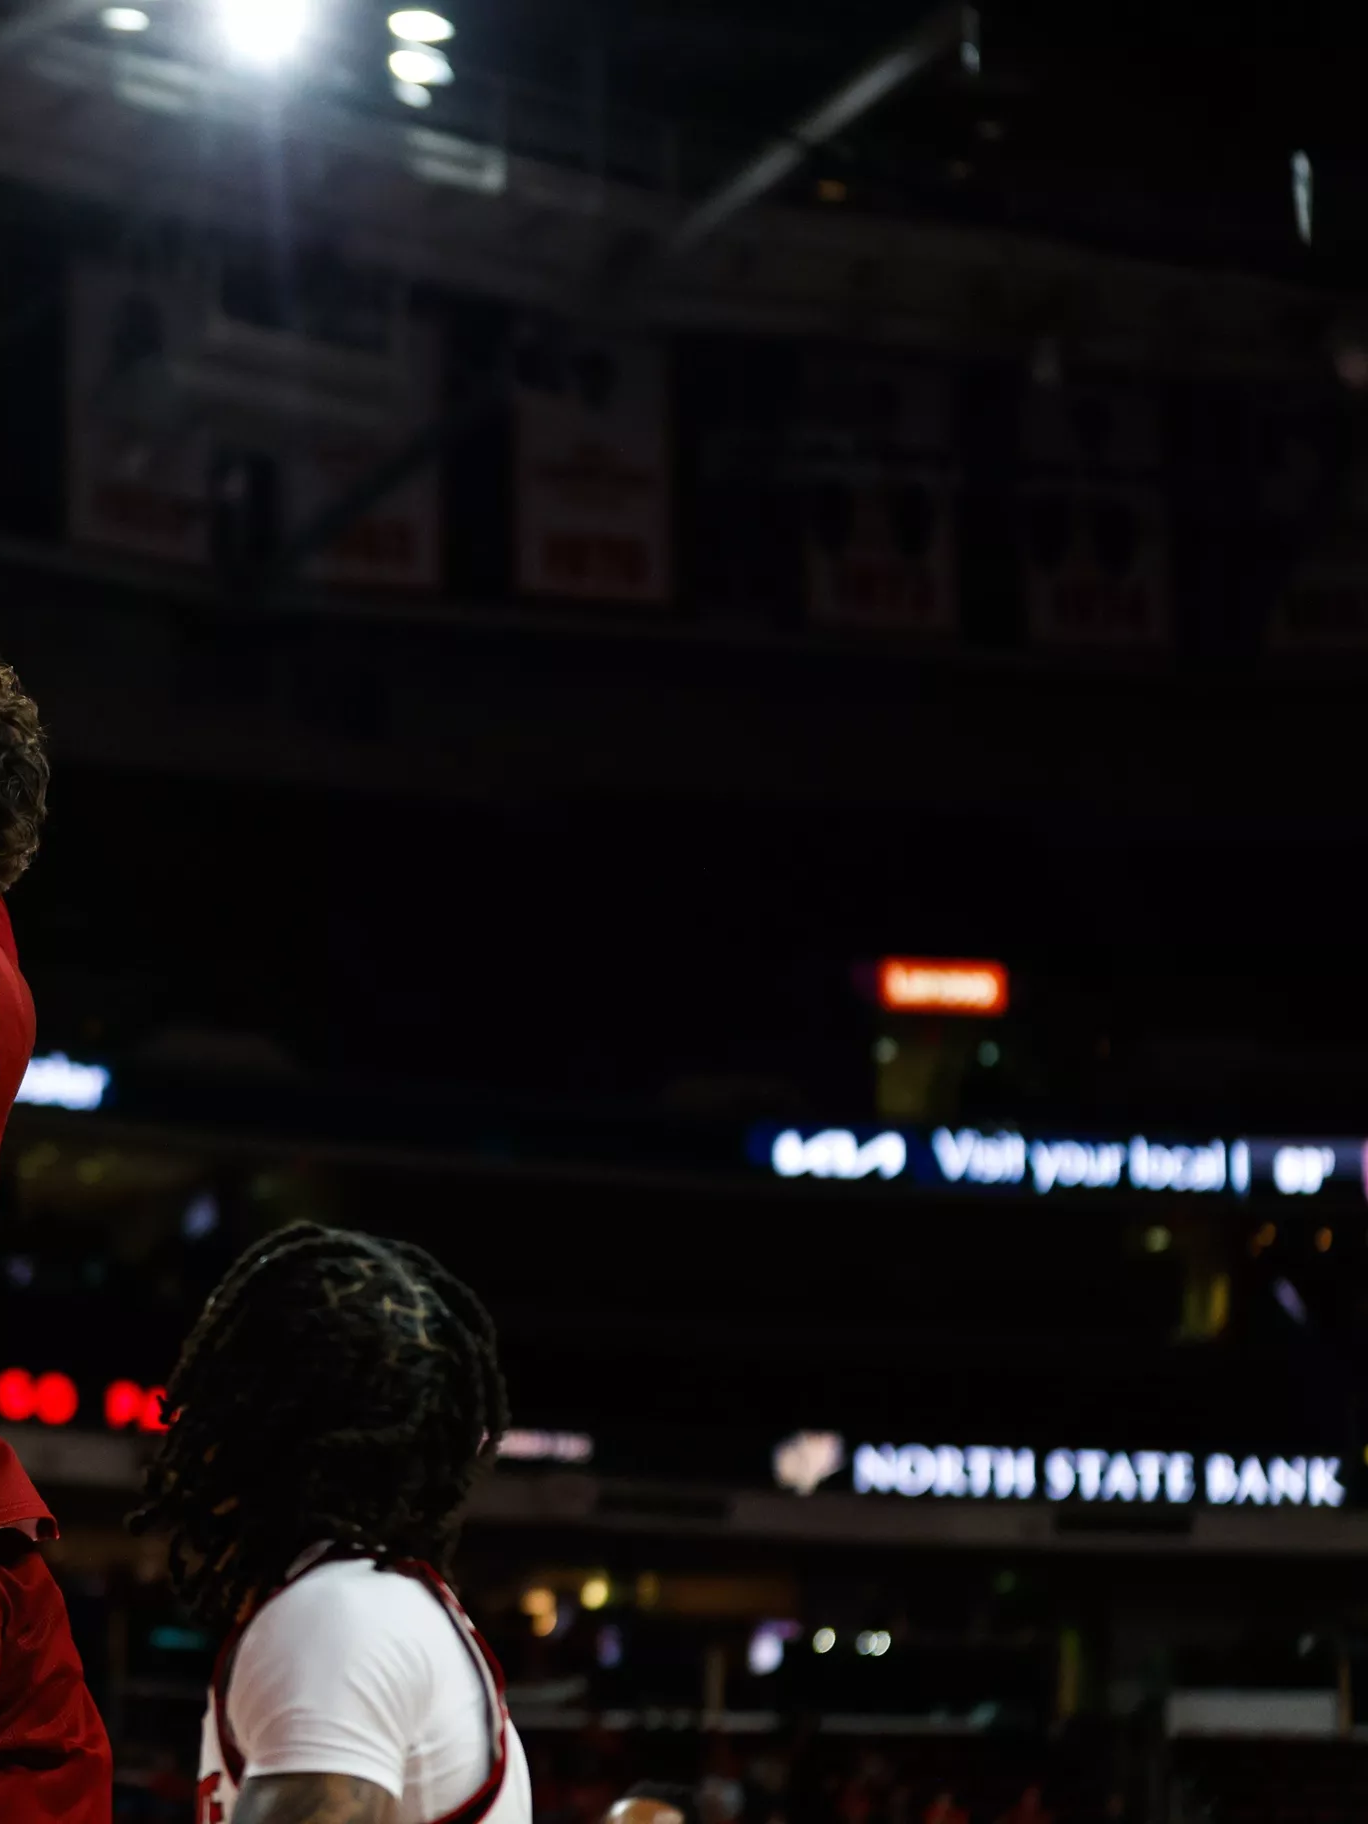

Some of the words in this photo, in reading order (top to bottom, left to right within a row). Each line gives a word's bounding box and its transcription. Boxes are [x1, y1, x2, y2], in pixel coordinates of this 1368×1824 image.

[853, 1443, 1036, 1499] NORTH
[1044, 1447, 1195, 1503] STATE
[1204, 1453, 1347, 1508] BANK
